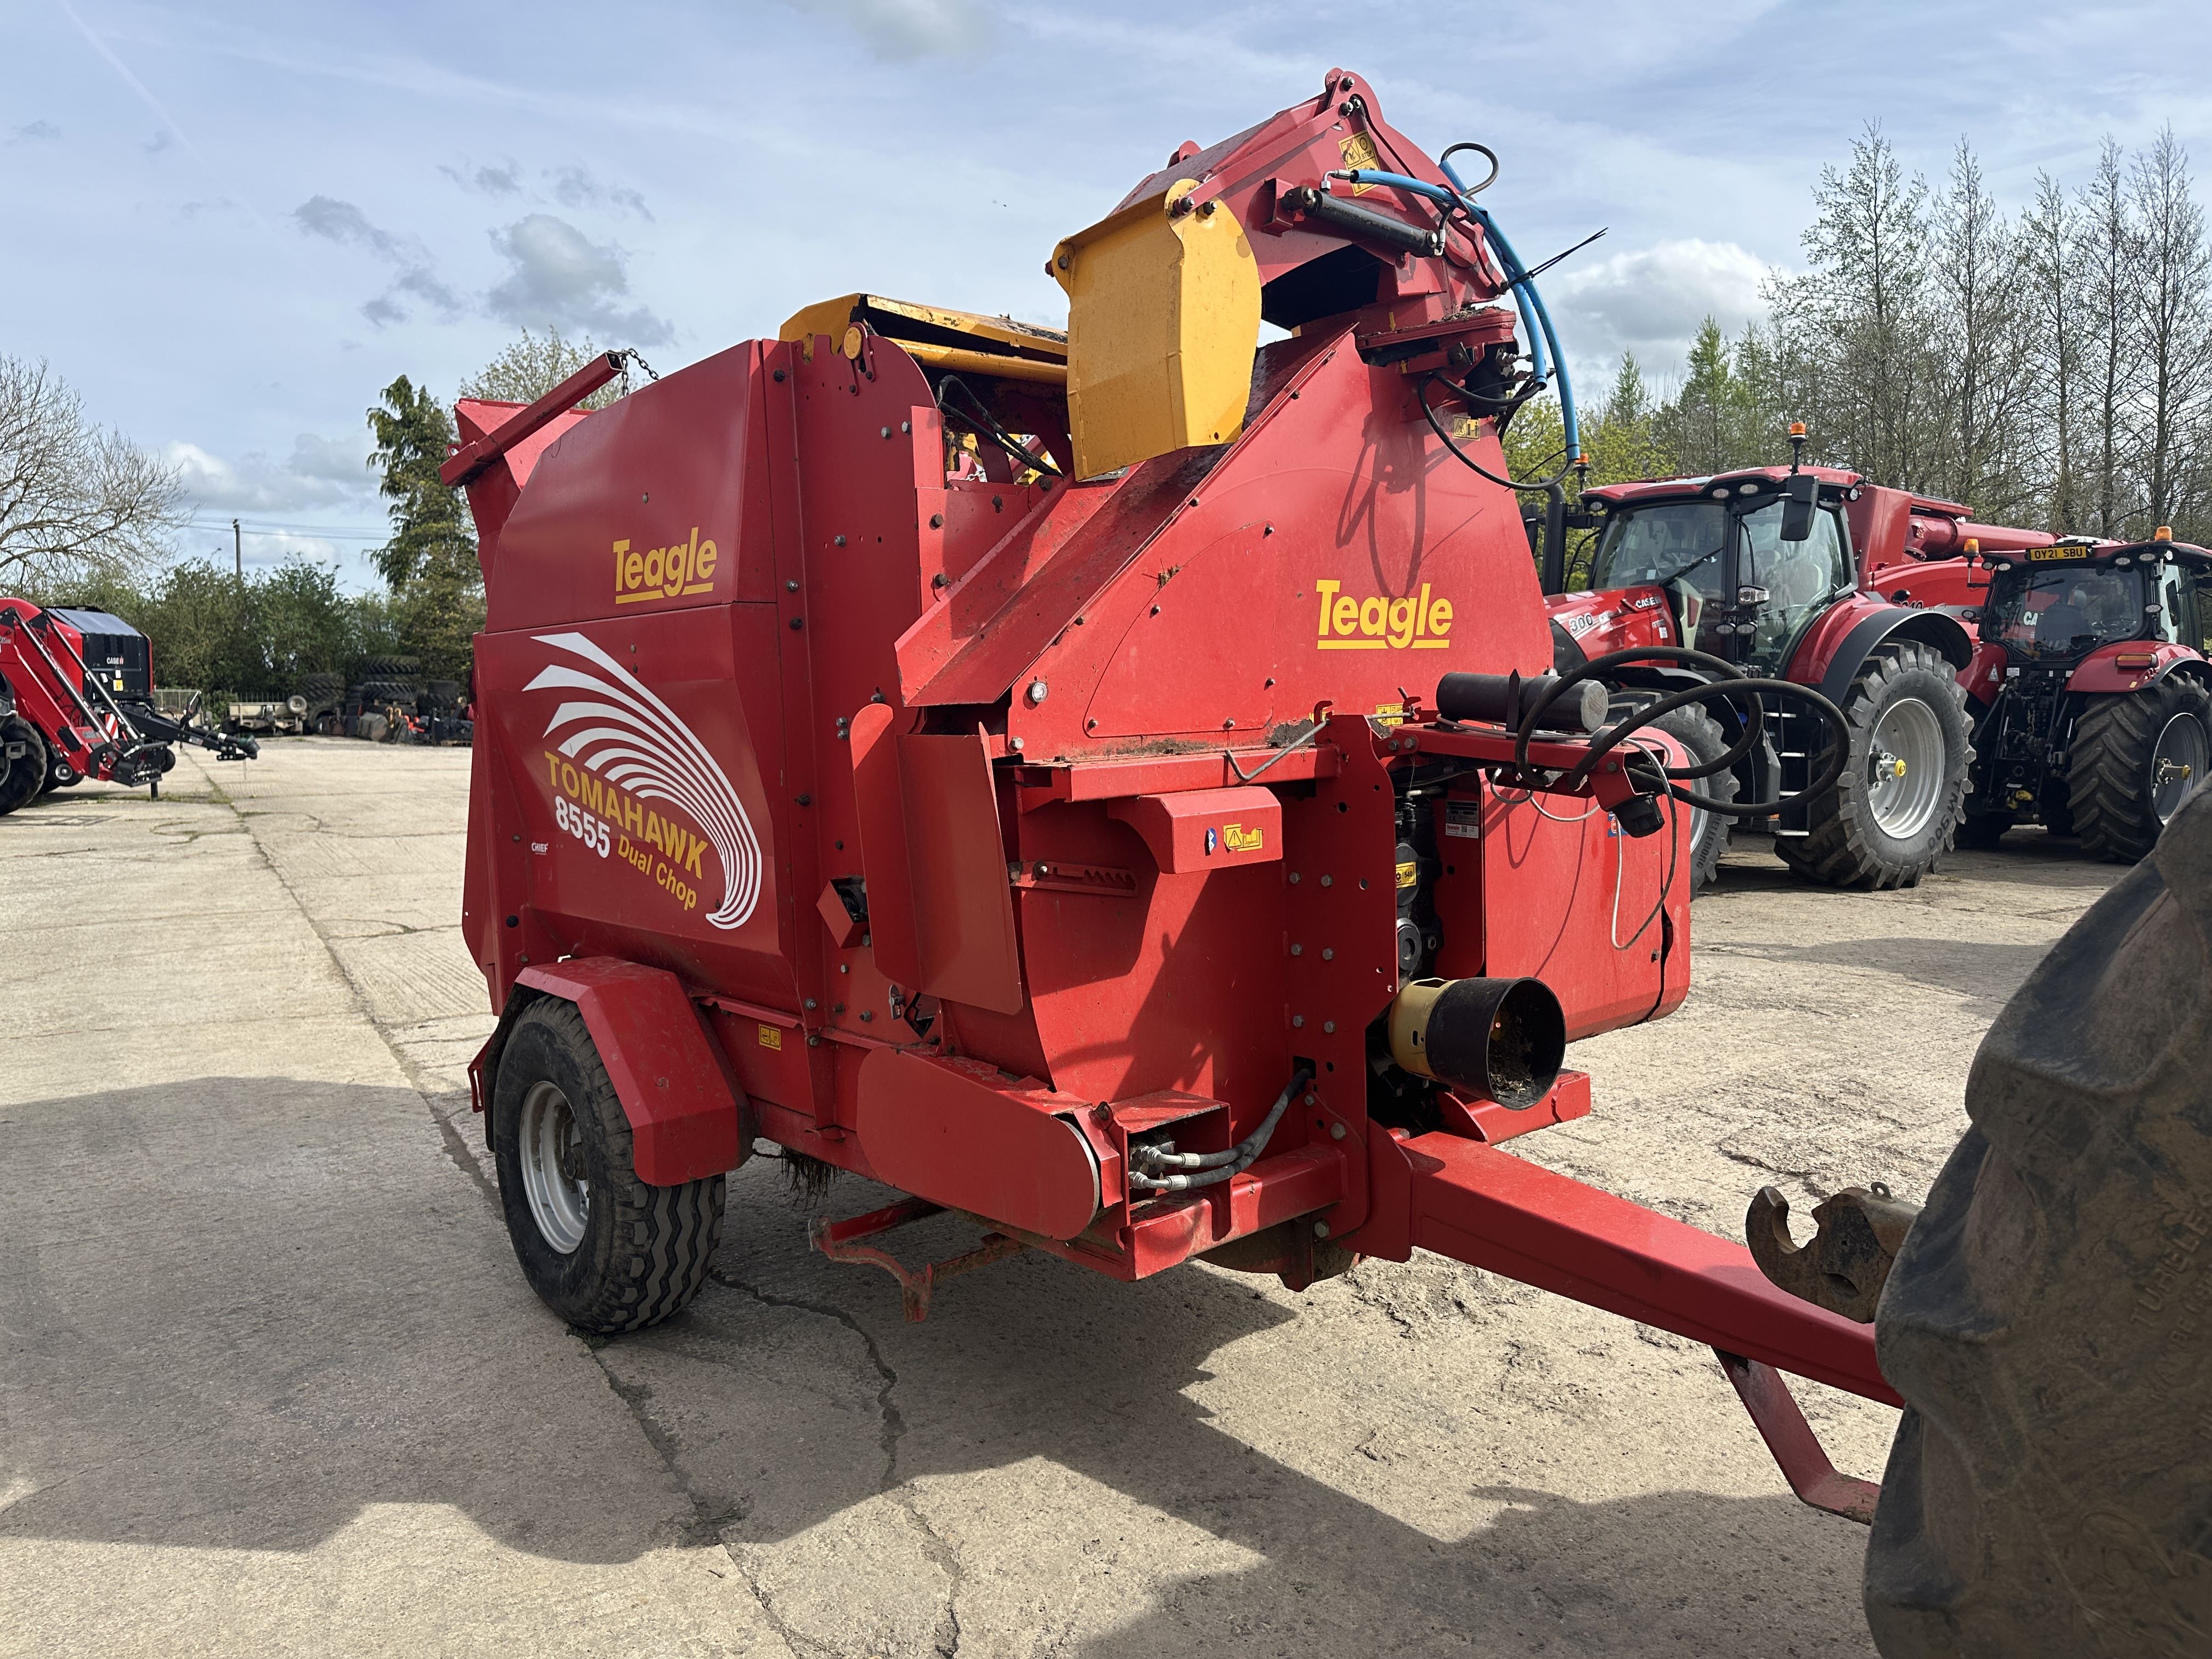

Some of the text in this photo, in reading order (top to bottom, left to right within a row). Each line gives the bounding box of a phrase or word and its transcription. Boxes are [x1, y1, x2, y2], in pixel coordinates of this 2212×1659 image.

[1361, 150, 1373, 160] STOP
[613, 526, 718, 597] Teagle
[2034, 548, 2083, 559] OY21 SBU
[1316, 579, 1454, 649] Teagle
[1635, 596, 1656, 609] CASE
[1568, 613, 1593, 633] 300
[106, 656, 119, 665] CASE
[545, 751, 708, 879] TOMAHAWK
[555, 795, 611, 858] 8555
[531, 842, 549, 853] CHIEF
[1696, 814, 1722, 869] RELLEBORG
[618, 834, 697, 911] Dual Chop
